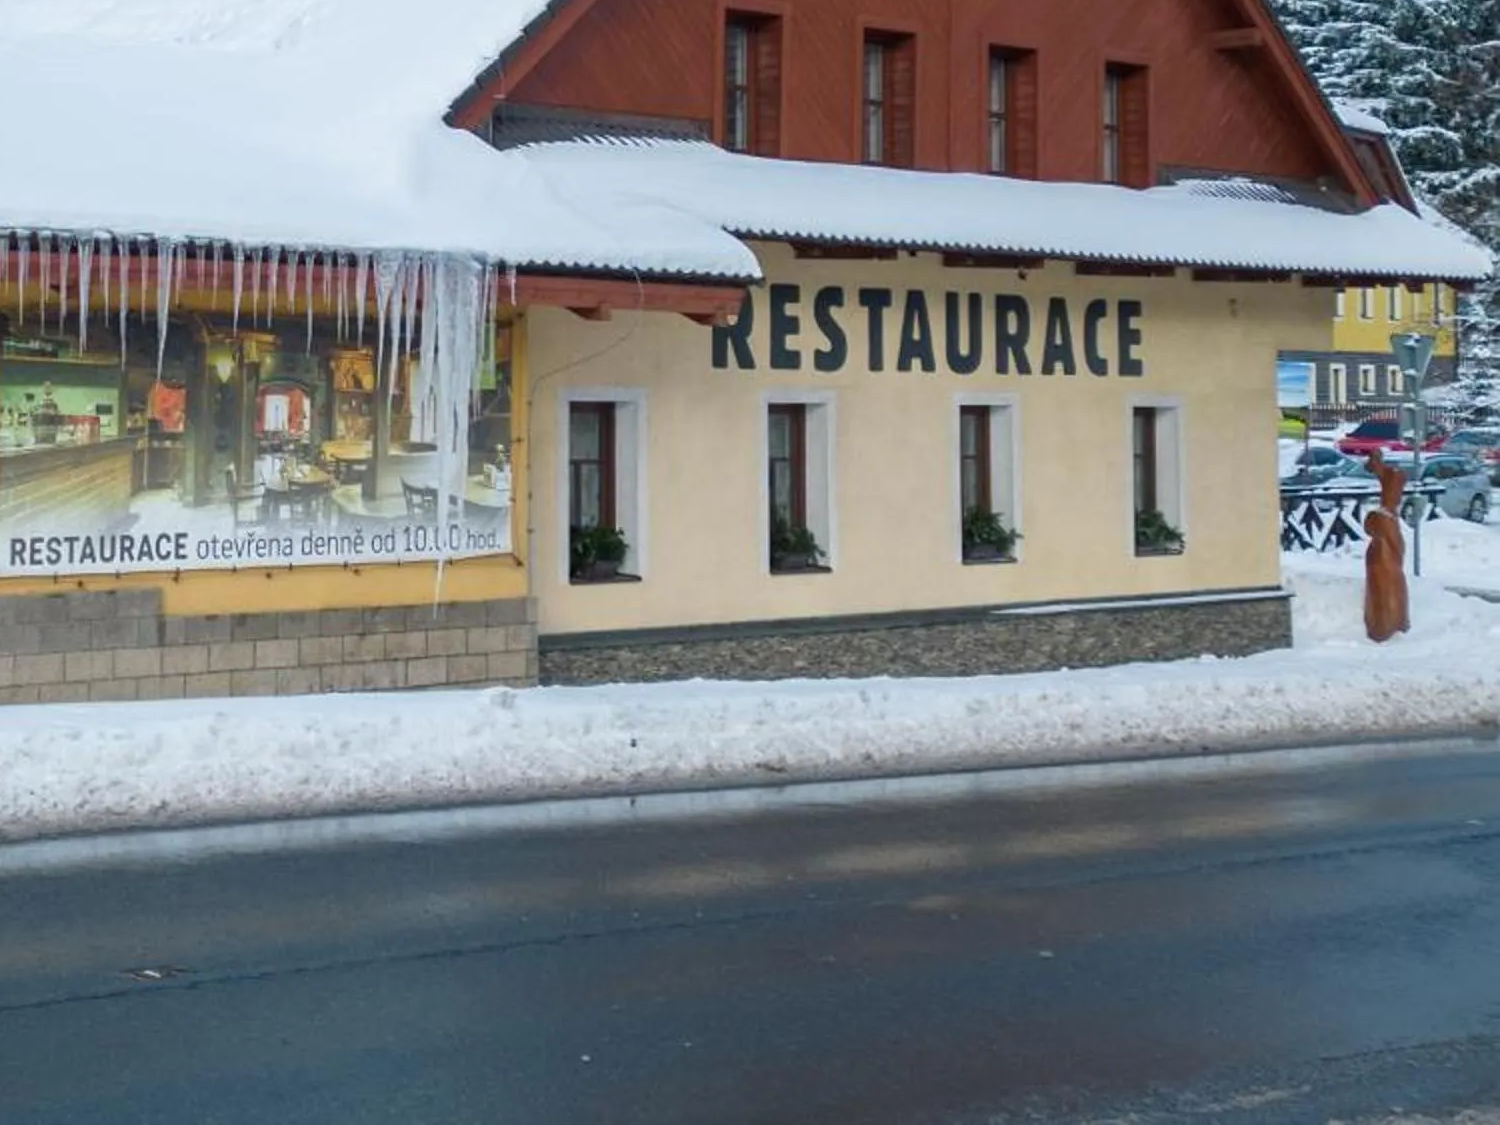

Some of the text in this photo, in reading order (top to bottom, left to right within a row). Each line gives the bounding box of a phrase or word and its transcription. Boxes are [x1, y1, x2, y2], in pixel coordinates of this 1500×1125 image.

[711, 283, 1144, 376] RESTAURACE
[9, 531, 189, 567] RESTAURACE
[196, 530, 293, 560] otevřena
[301, 526, 365, 556] denně
[371, 527, 396, 554] od
[466, 527, 501, 550] hod.
